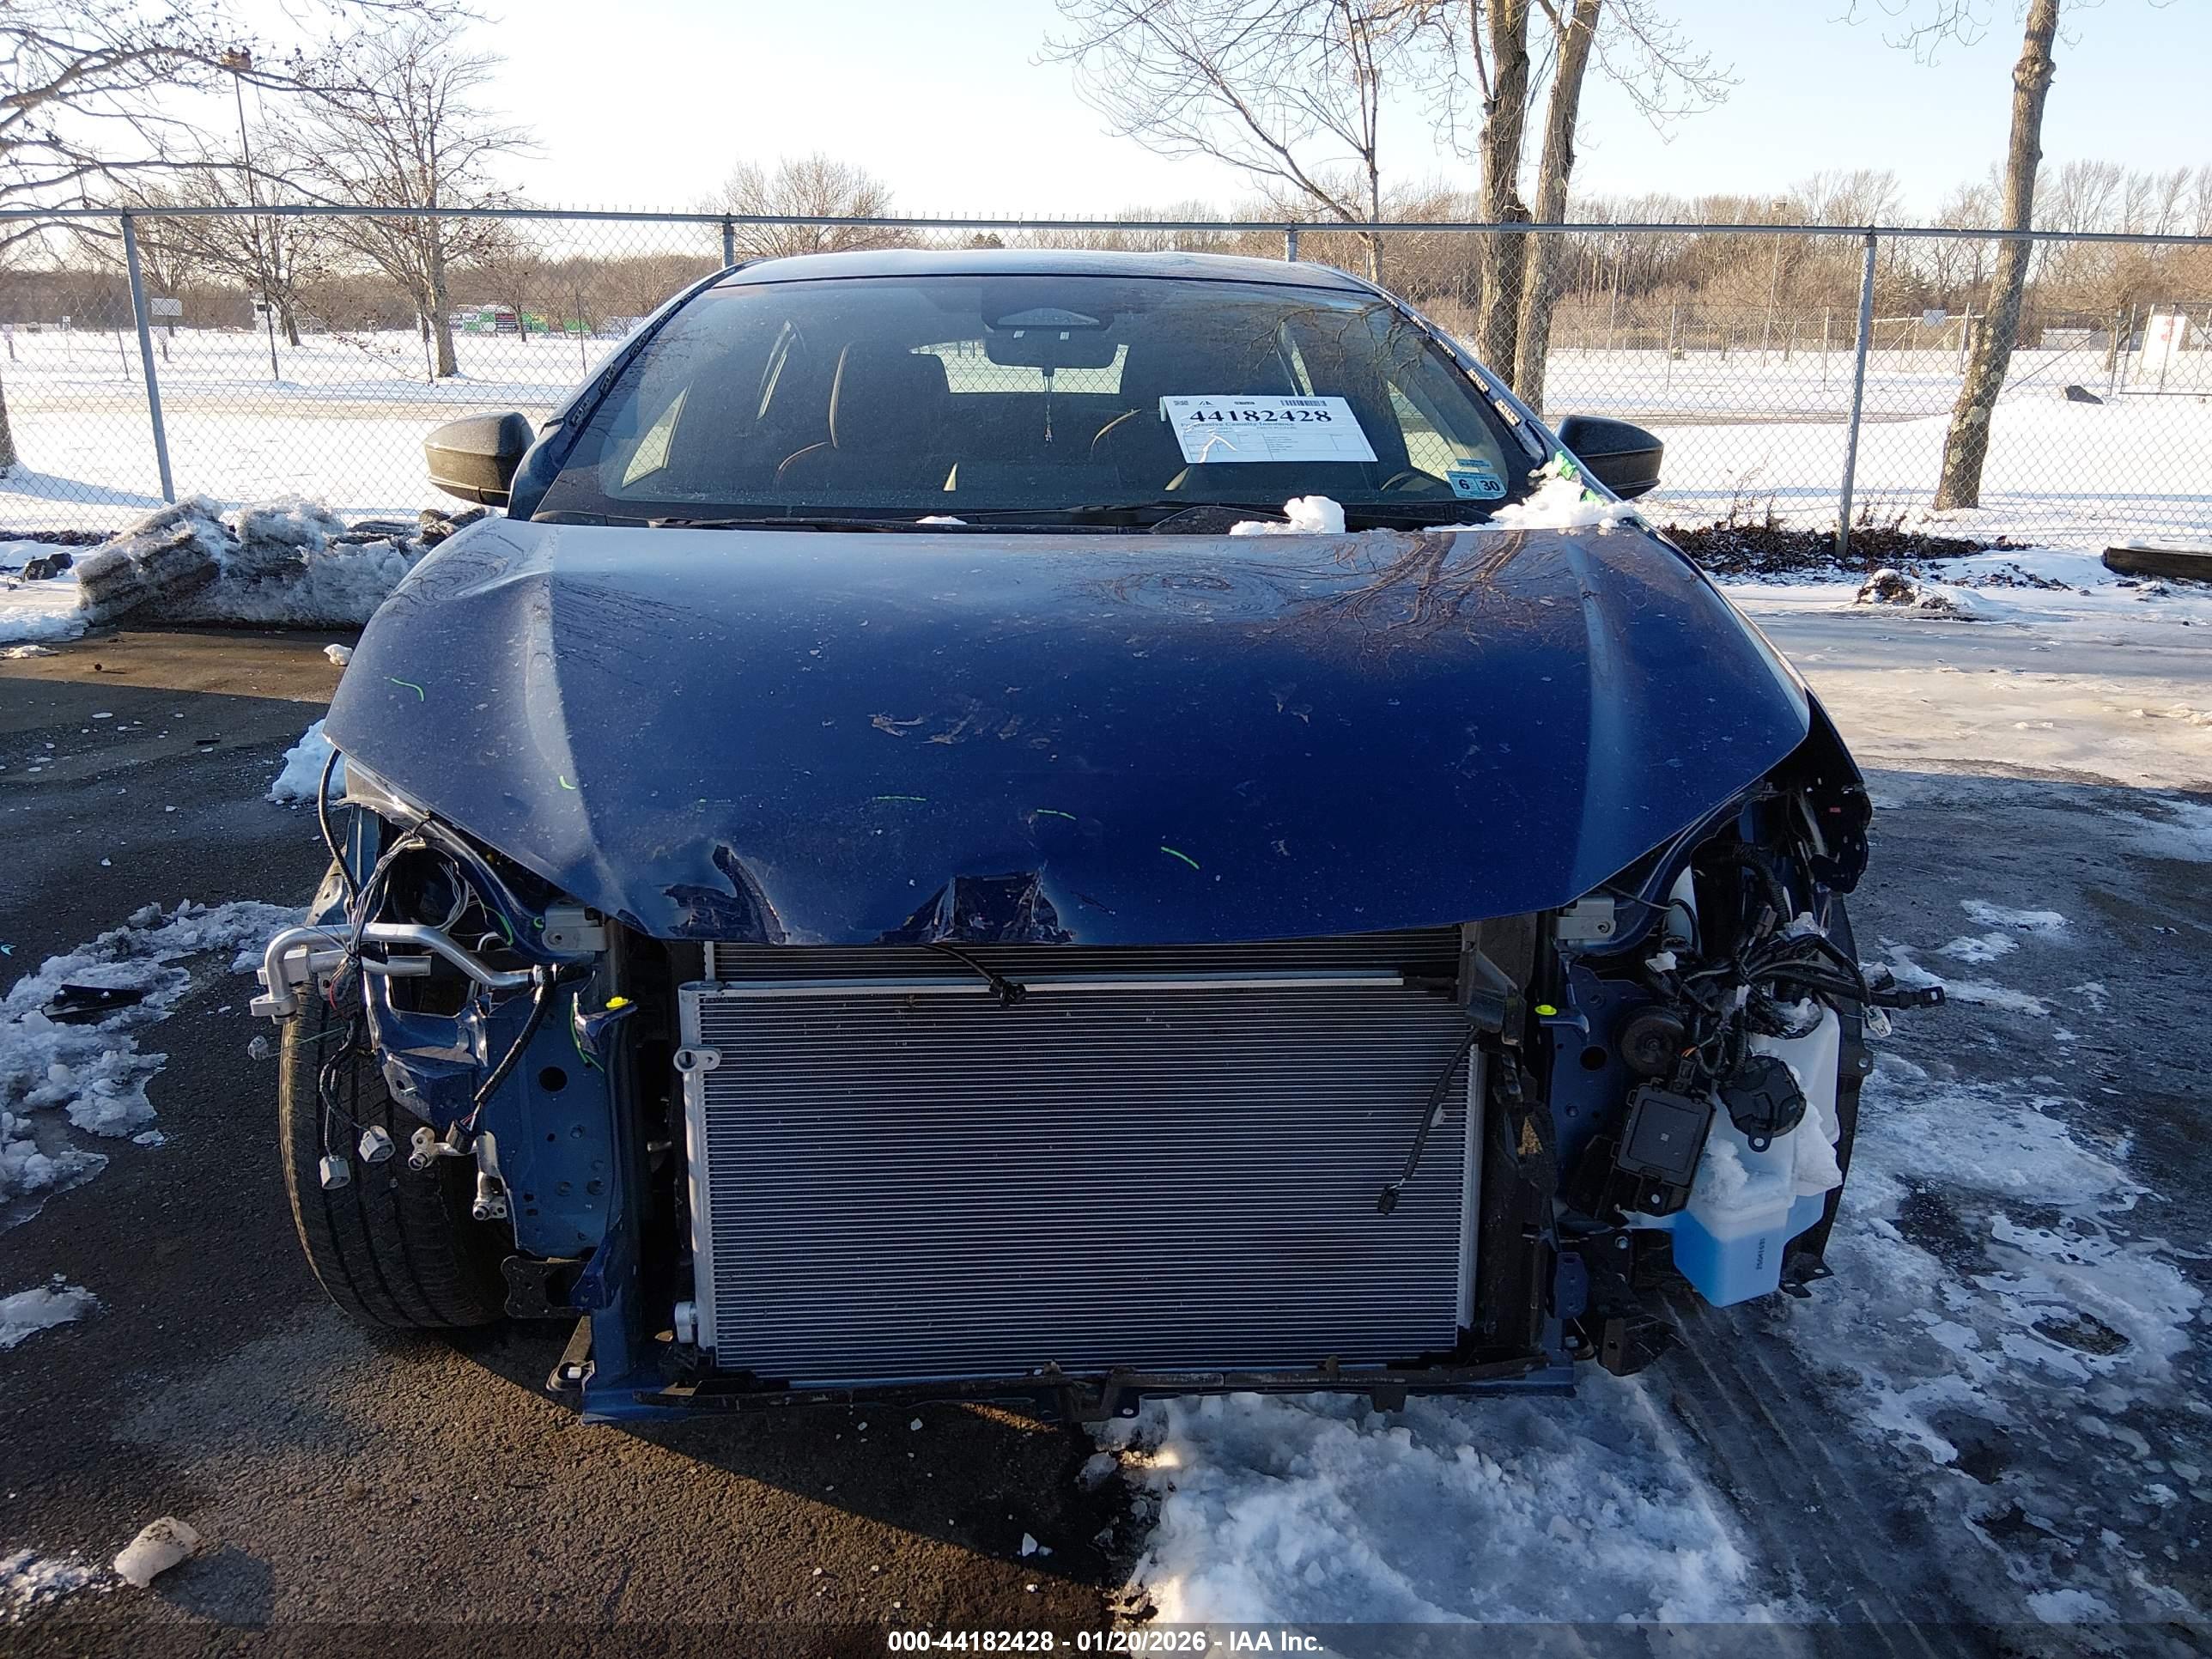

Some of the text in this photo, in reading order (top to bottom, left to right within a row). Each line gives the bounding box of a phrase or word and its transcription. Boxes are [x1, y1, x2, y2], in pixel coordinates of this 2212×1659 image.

[1189, 410, 1332, 422] 44182428
[1458, 478, 1500, 491] 6 30
